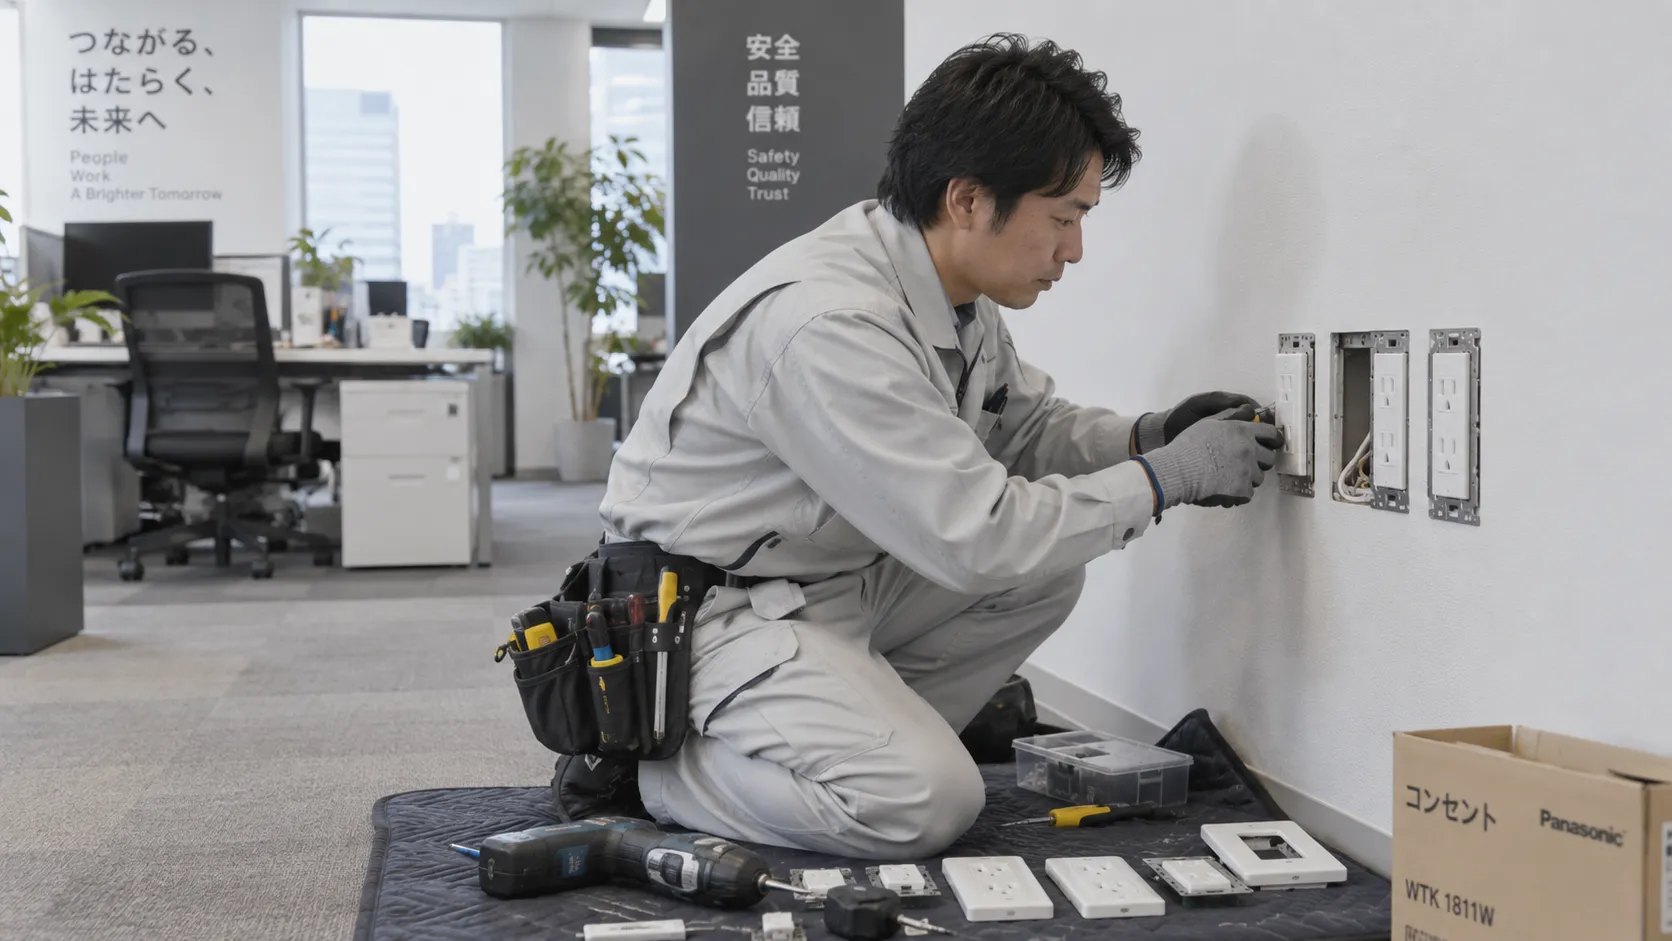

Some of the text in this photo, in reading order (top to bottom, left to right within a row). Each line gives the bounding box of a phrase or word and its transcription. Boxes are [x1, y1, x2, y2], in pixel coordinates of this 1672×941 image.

[69, 28, 213, 56] つながる、
[746, 33, 800, 60] 安全
[71, 67, 213, 95] はたらく、
[747, 69, 800, 96] 品質
[69, 105, 167, 134] 未来へ
[746, 104, 800, 133] 信頼
[70, 150, 128, 166] People
[747, 148, 800, 166] Safety
[70, 169, 111, 182] Work
[747, 167, 800, 184] Quality
[71, 187, 222, 203] A Brighter Tomorrow
[747, 186, 789, 200] Trust
[1406, 784, 1496, 832] コンセント
[1540, 808, 1624, 847] Panasonic
[1405, 878, 1495, 927] WTK 1811W
